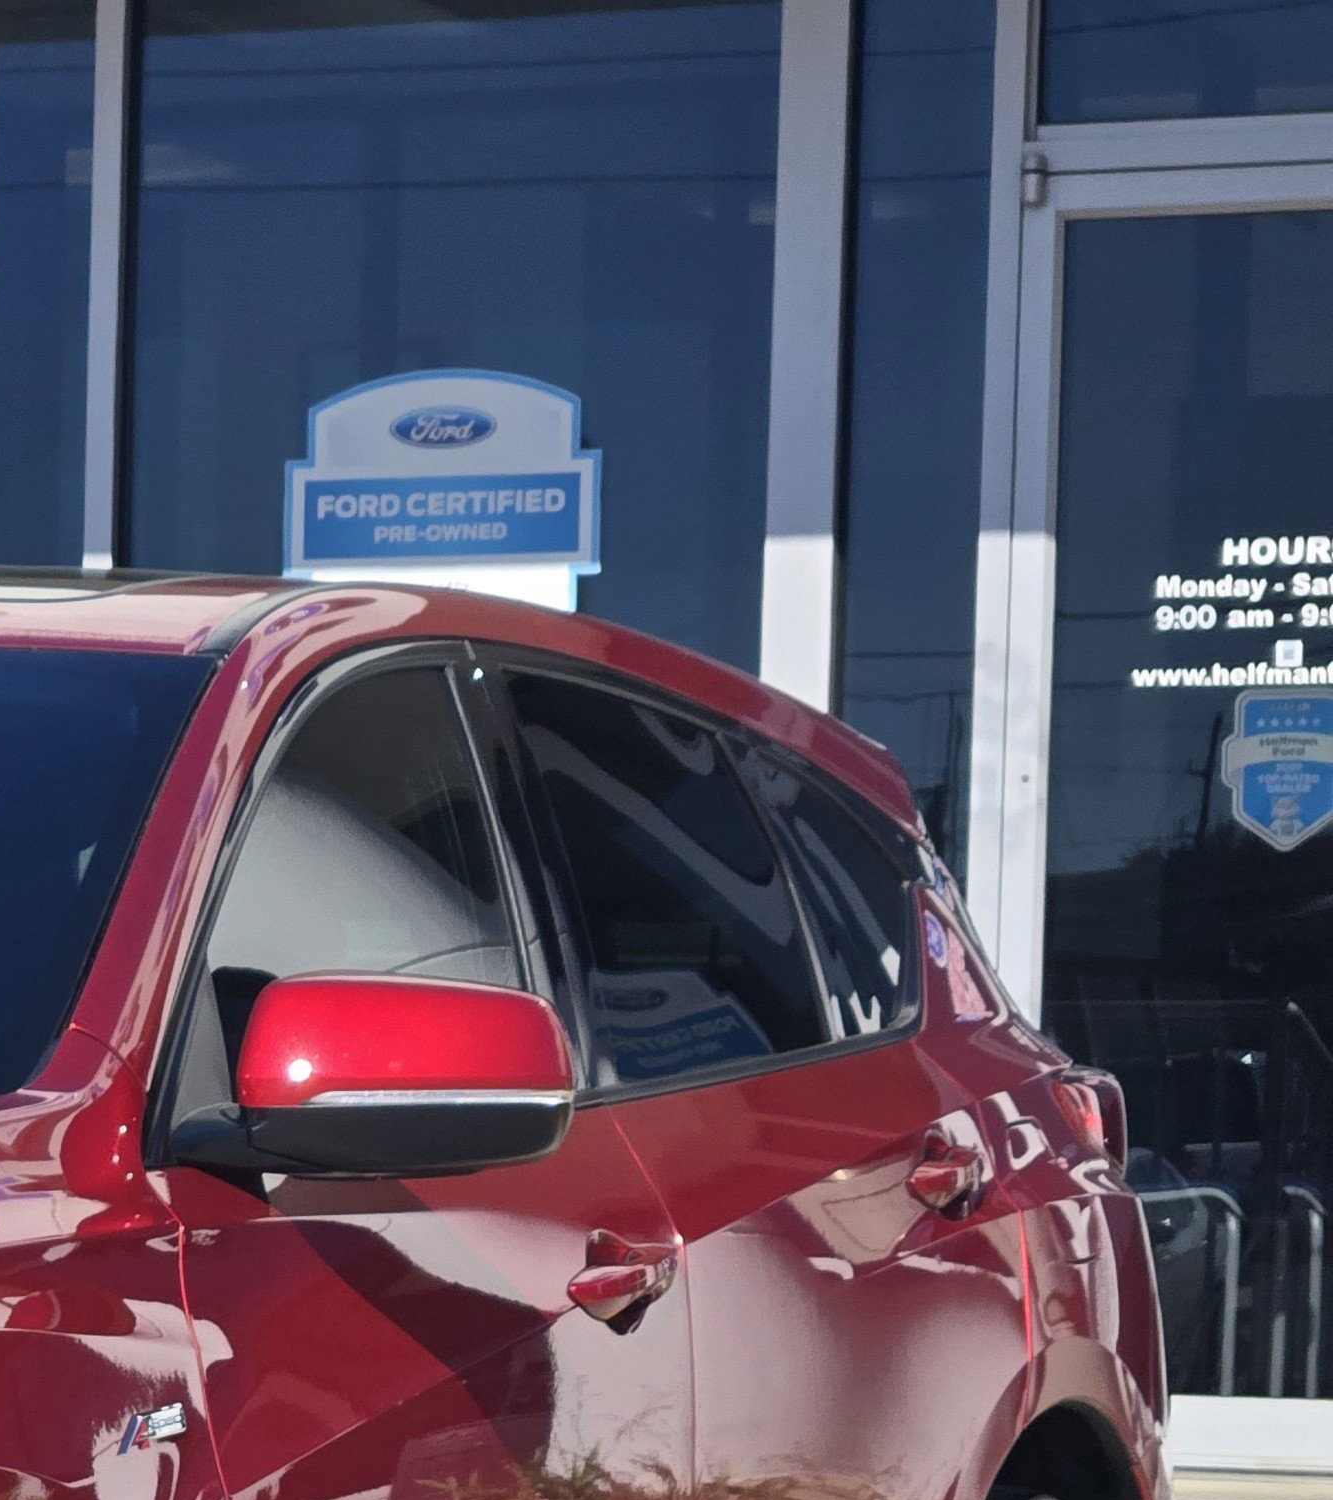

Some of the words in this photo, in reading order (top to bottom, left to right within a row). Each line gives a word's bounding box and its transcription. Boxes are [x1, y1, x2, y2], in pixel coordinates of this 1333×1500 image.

[410, 413, 476, 442] Ford
[317, 493, 401, 520] FORD
[406, 487, 566, 517] CERTIFIED
[374, 522, 507, 544] PRE-OWNED
[1222, 535, 1333, 566] HOUR
[1156, 573, 1268, 602] Monday
[1155, 603, 1217, 631] 9:00
[1227, 608, 1274, 629] am
[1300, 602, 1333, 627] 9:
